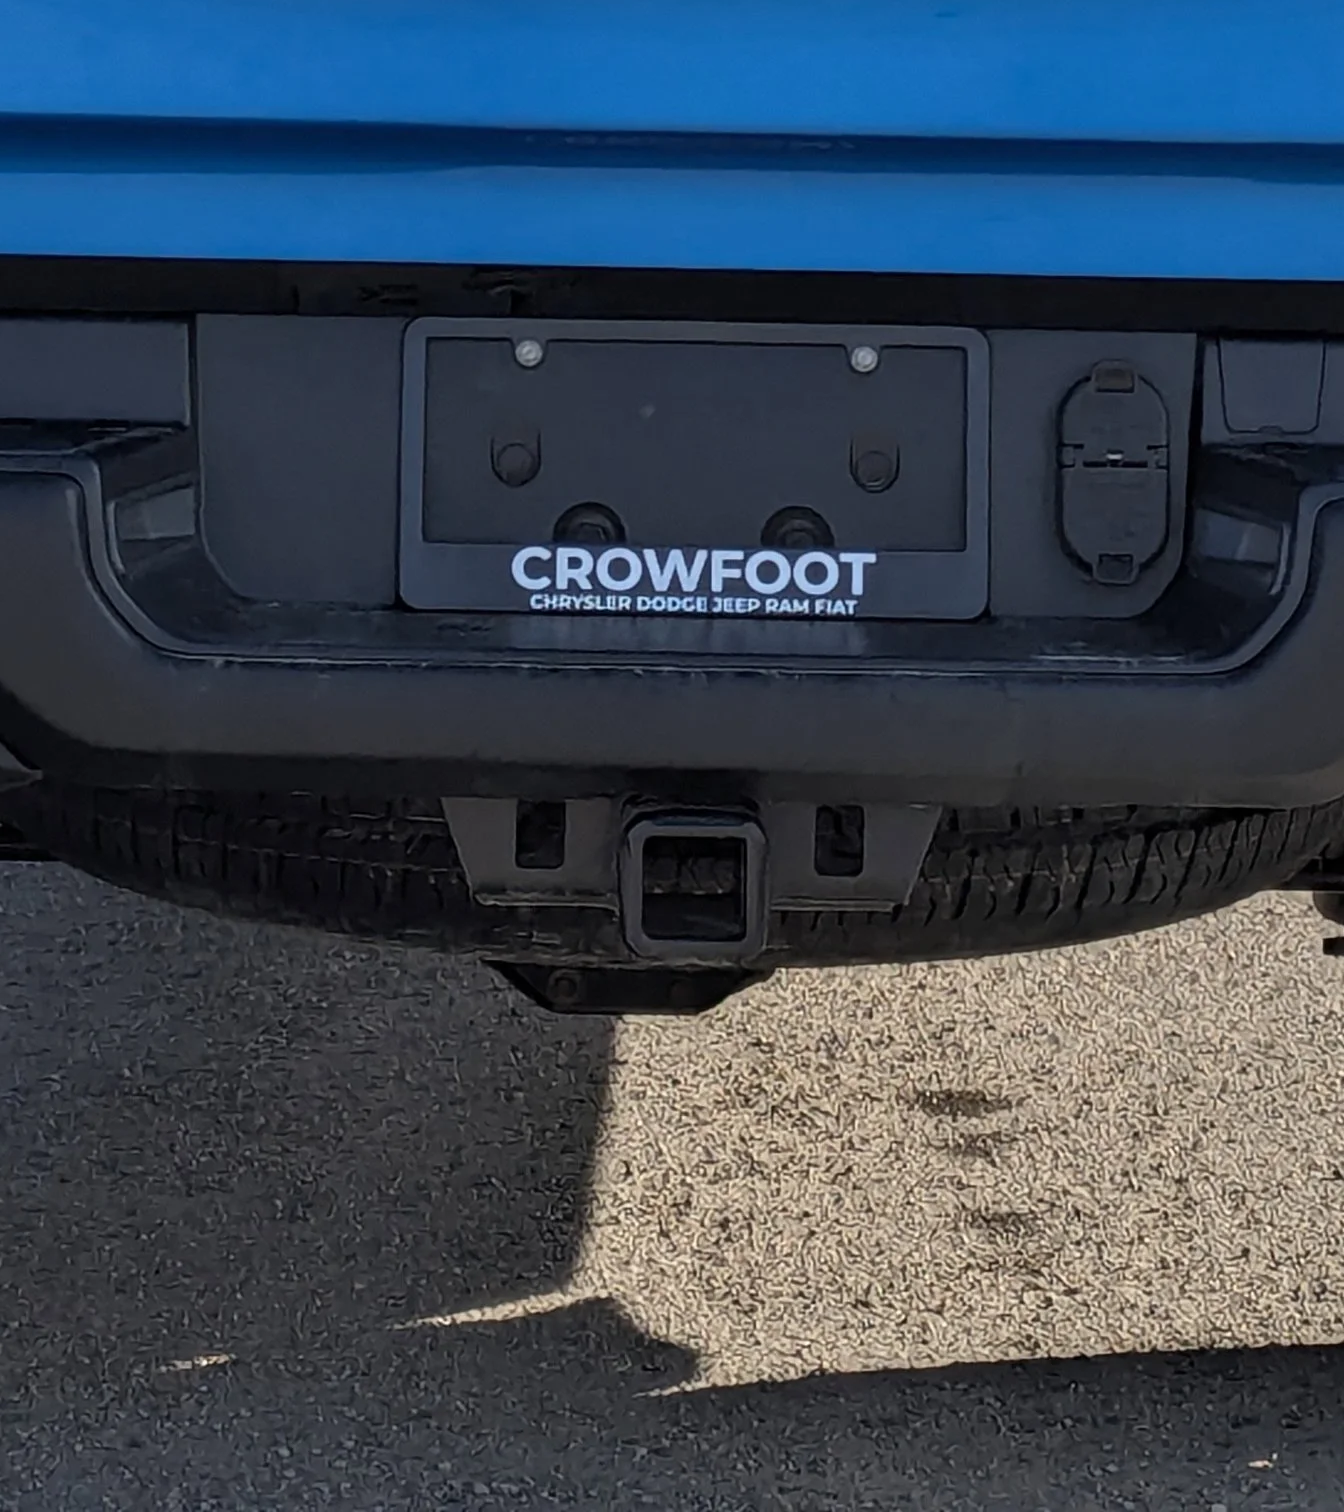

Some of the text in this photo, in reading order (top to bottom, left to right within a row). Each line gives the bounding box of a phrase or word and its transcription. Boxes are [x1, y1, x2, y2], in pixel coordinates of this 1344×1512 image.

[510, 546, 877, 596] CROWFOOT
[529, 593, 859, 616] CHRYSLER DODGE JEEP RAM FIAT
